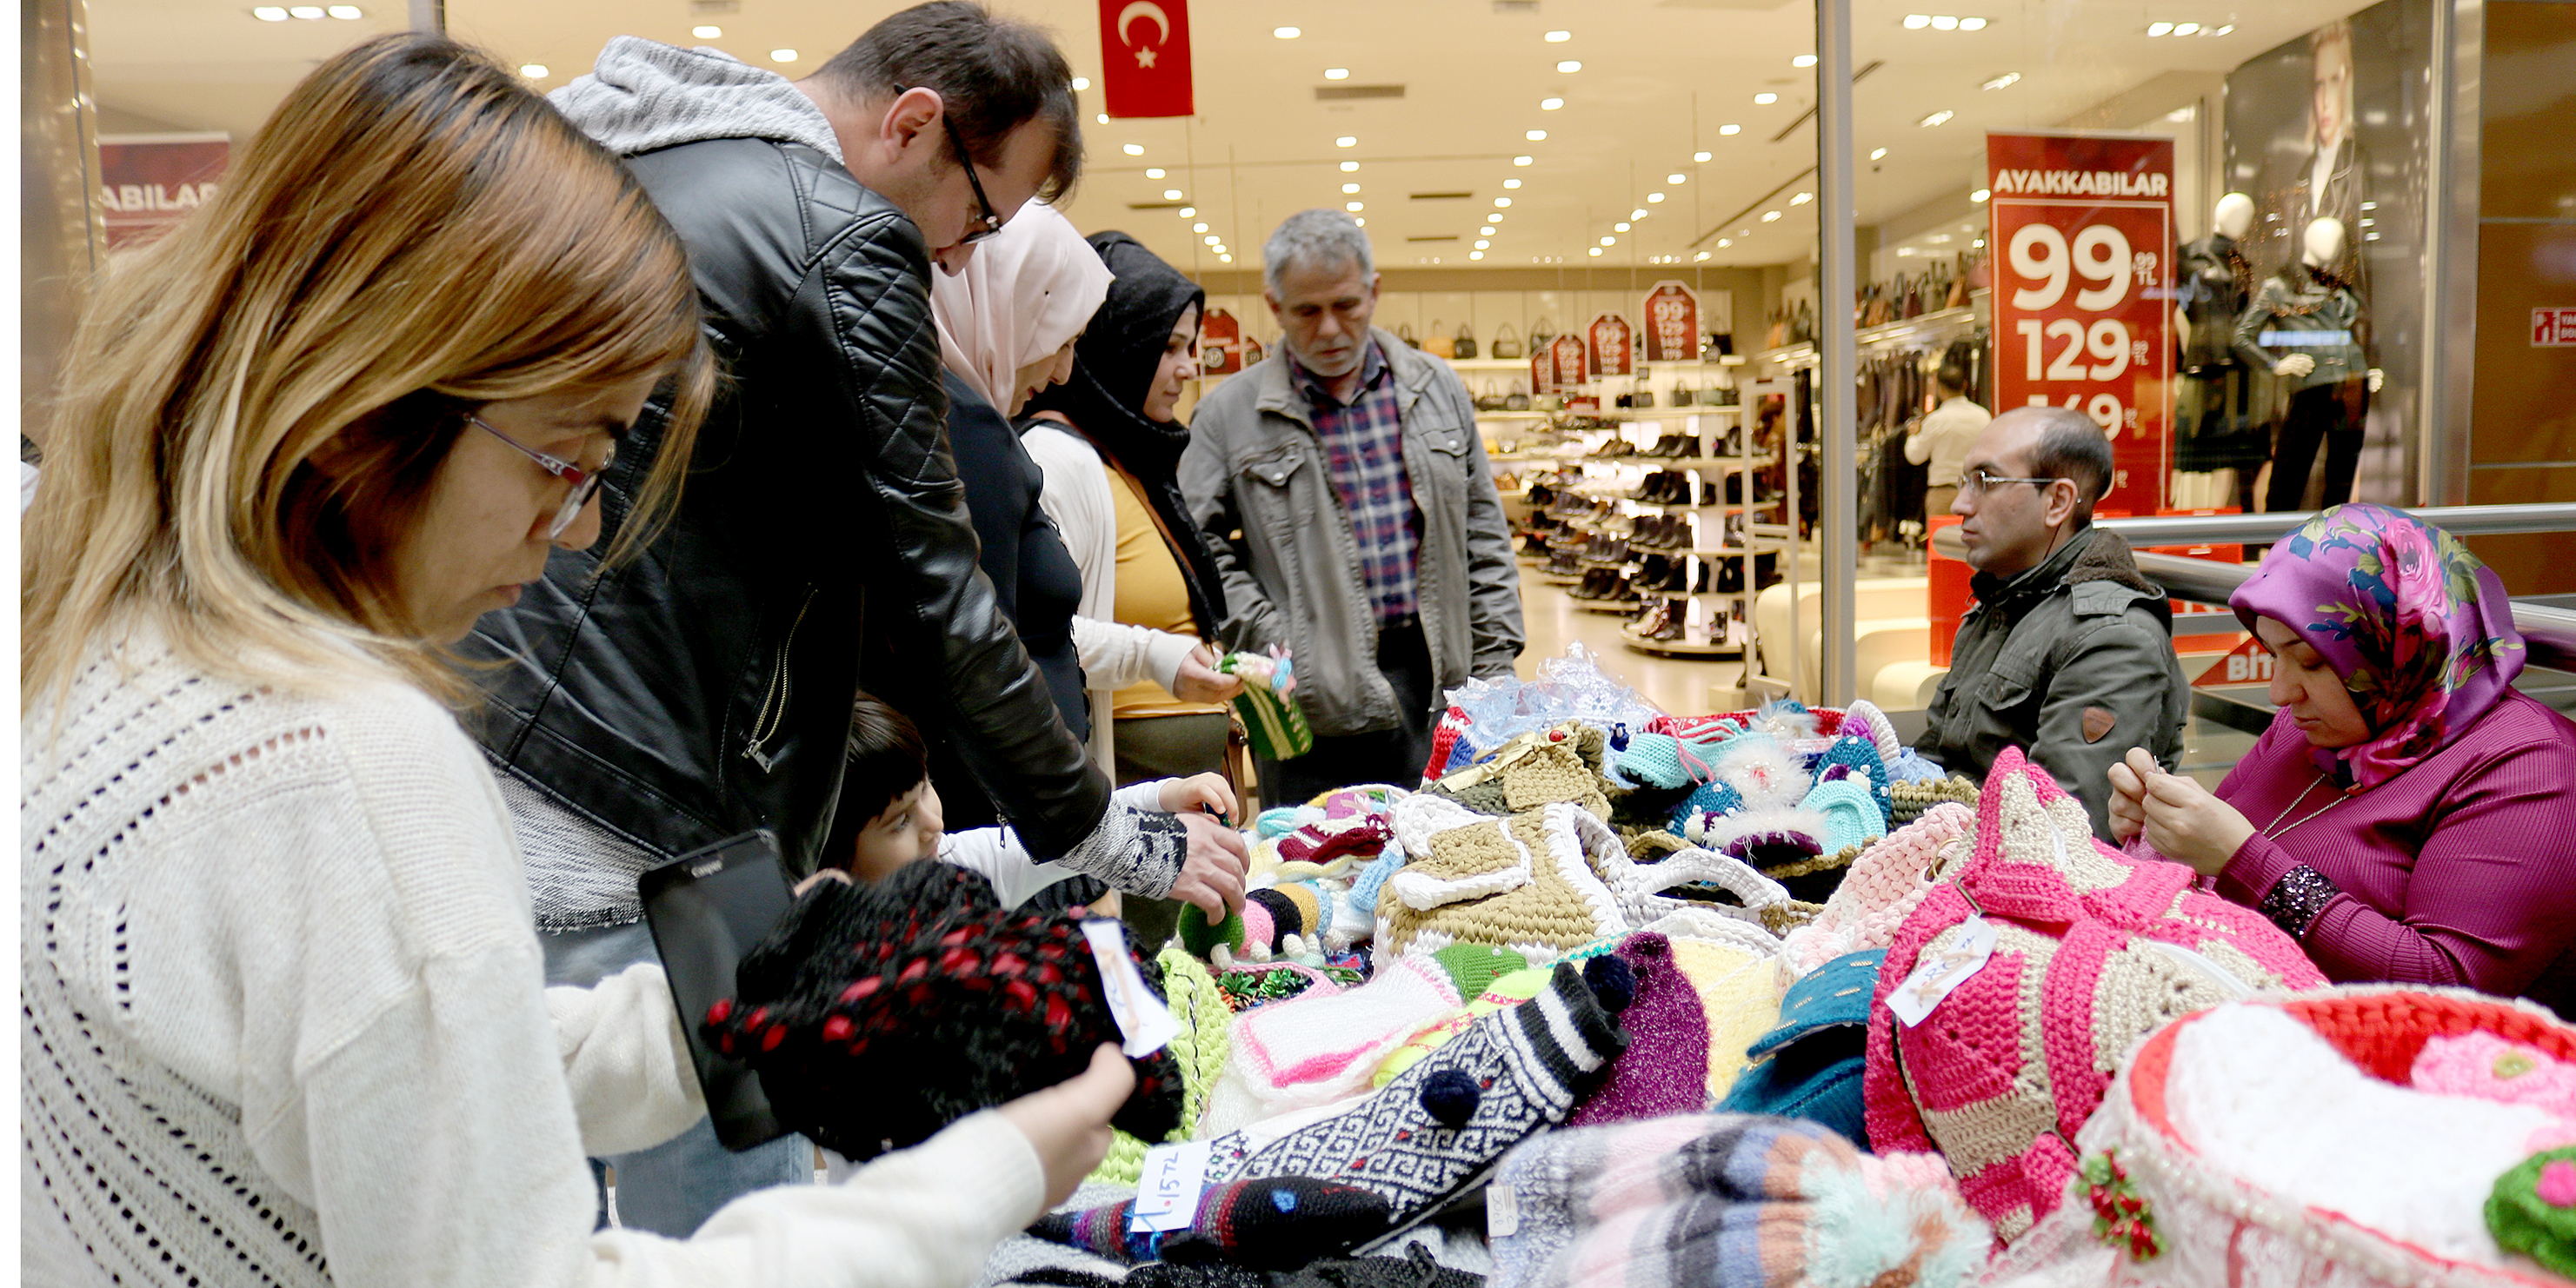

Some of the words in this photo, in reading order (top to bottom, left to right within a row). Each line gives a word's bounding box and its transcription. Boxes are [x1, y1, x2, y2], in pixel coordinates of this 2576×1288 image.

[1993, 169, 2168, 197] AYAKKABILAR
[2008, 222, 2132, 312] 99
[2137, 271, 2158, 286] TL
[2016, 318, 2131, 382] 129
